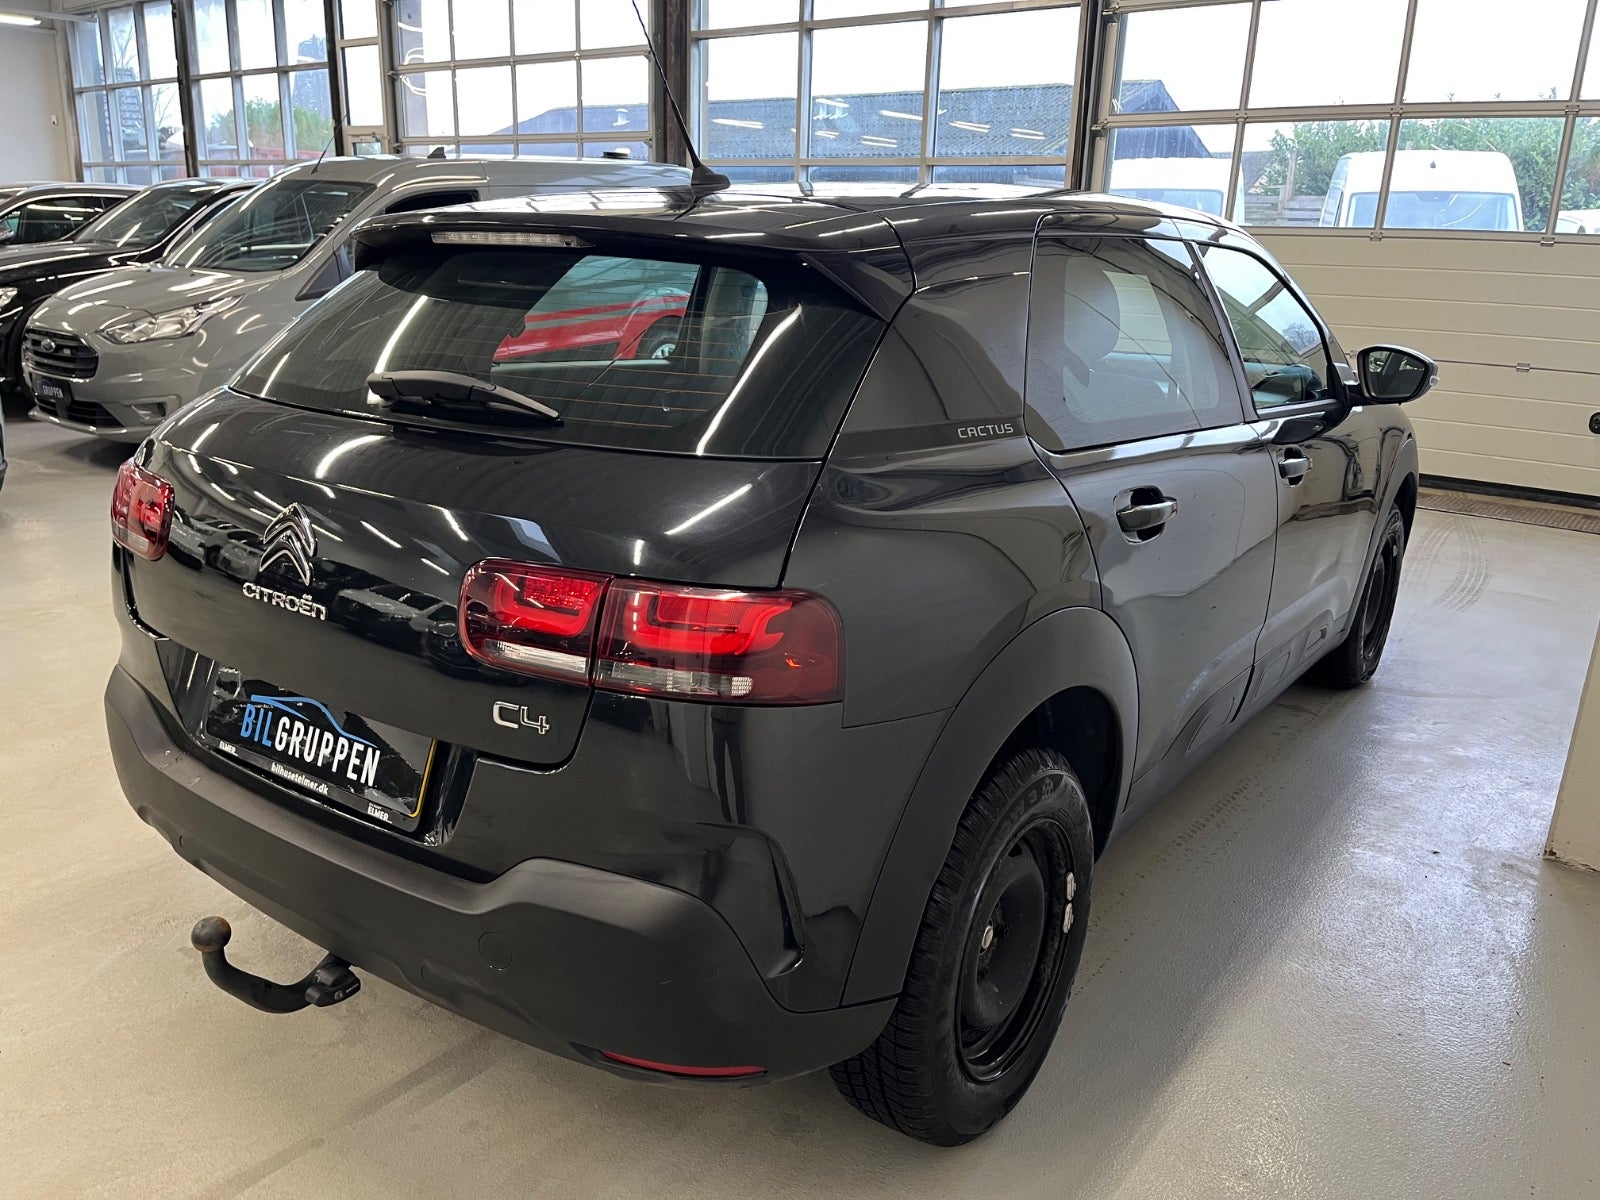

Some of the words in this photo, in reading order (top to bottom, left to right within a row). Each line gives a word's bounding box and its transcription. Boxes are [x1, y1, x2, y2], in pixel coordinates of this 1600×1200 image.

[957, 423, 1013, 438] CACTUS
[493, 701, 550, 734] C4
[240, 703, 381, 787] BILGRUPPEN
[271, 761, 329, 796] bilhusetelmer.dk
[367, 805, 390, 821] ELMER
